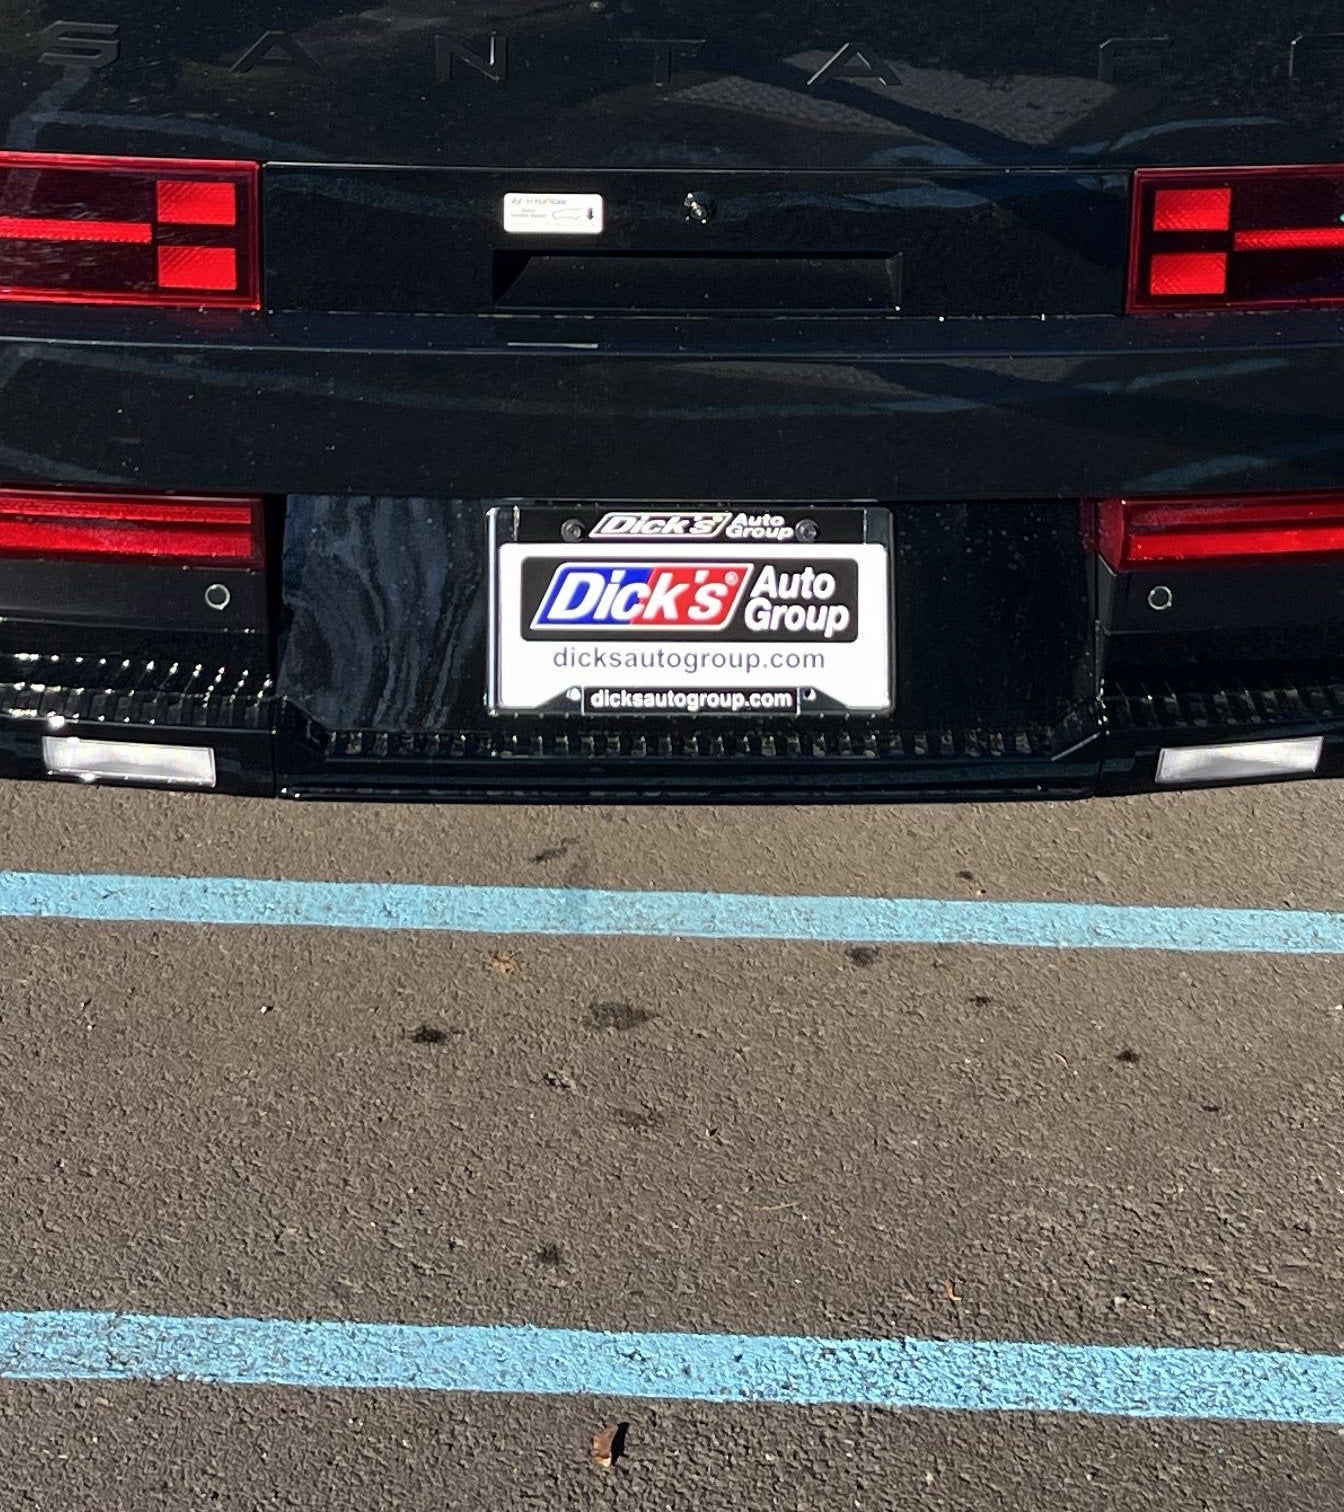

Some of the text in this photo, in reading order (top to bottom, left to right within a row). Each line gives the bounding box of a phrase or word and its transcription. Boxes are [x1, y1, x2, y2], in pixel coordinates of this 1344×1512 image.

[38, 19, 904, 86] SANTA
[599, 514, 714, 535] Dick's
[725, 524, 795, 540] Group
[730, 512, 785, 527] Auto
[546, 569, 729, 621] Dick's
[749, 564, 836, 600] Auto
[744, 596, 851, 638] Group
[552, 646, 826, 674] dicksautogroup.com
[590, 689, 794, 711] dicksautogroup.com
